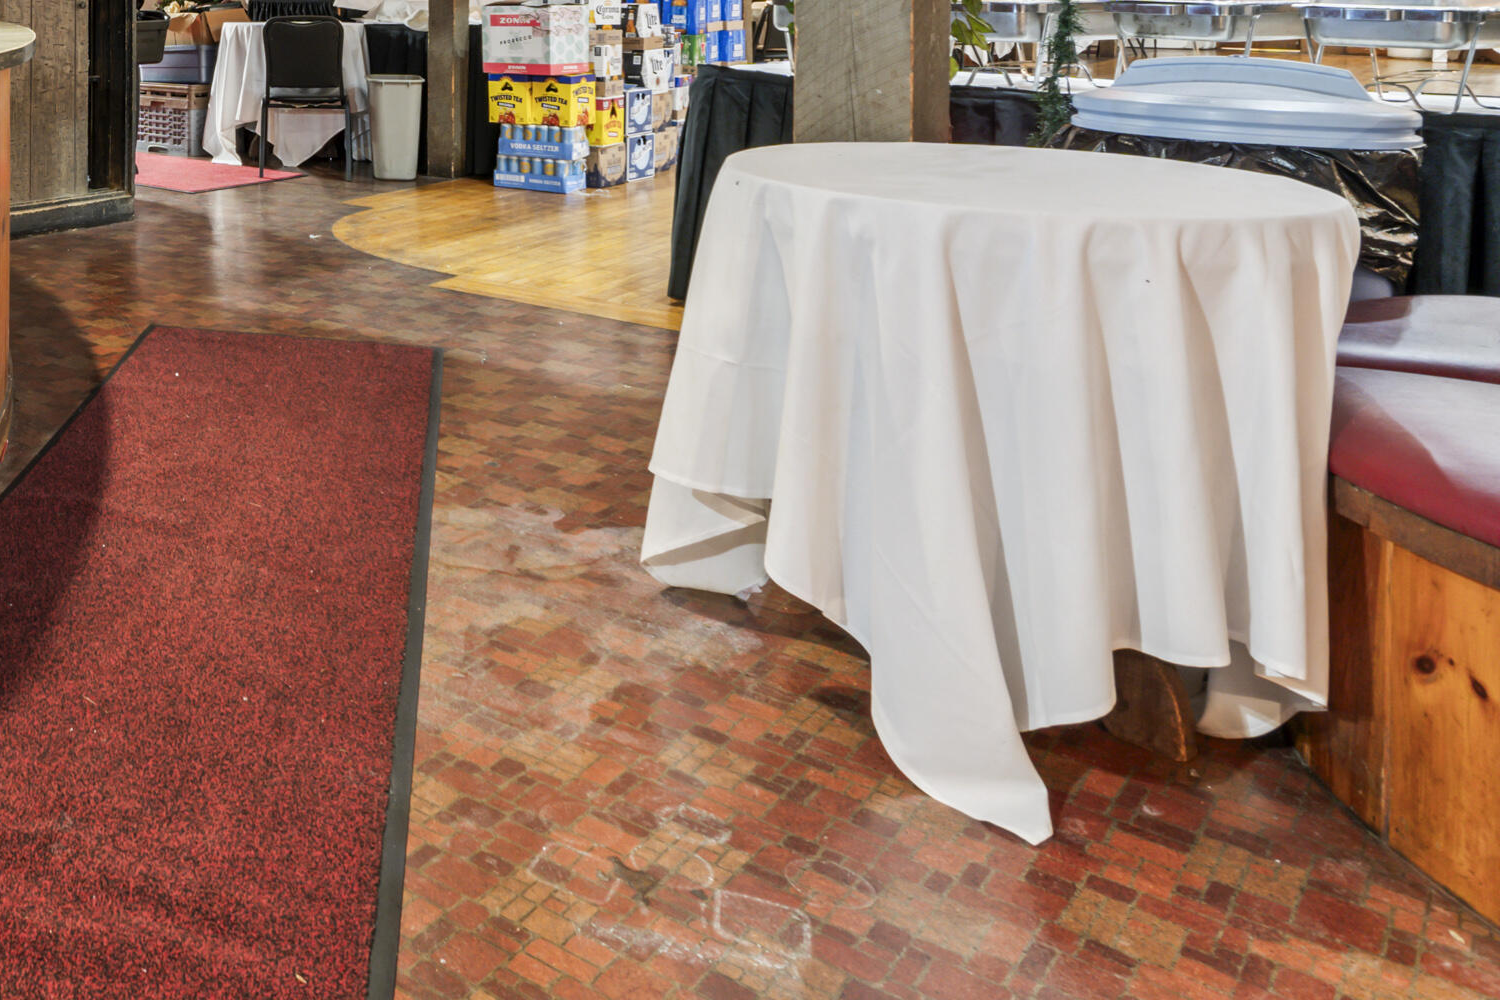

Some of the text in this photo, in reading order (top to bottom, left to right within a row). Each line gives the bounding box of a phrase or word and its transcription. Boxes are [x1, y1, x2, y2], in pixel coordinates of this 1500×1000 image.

[645, 13, 658, 29] Lite
[650, 57, 663, 75] Lite
[513, 95, 523, 103] TEA
[558, 97, 568, 105] TEA
[532, 144, 559, 152] SELTZER
